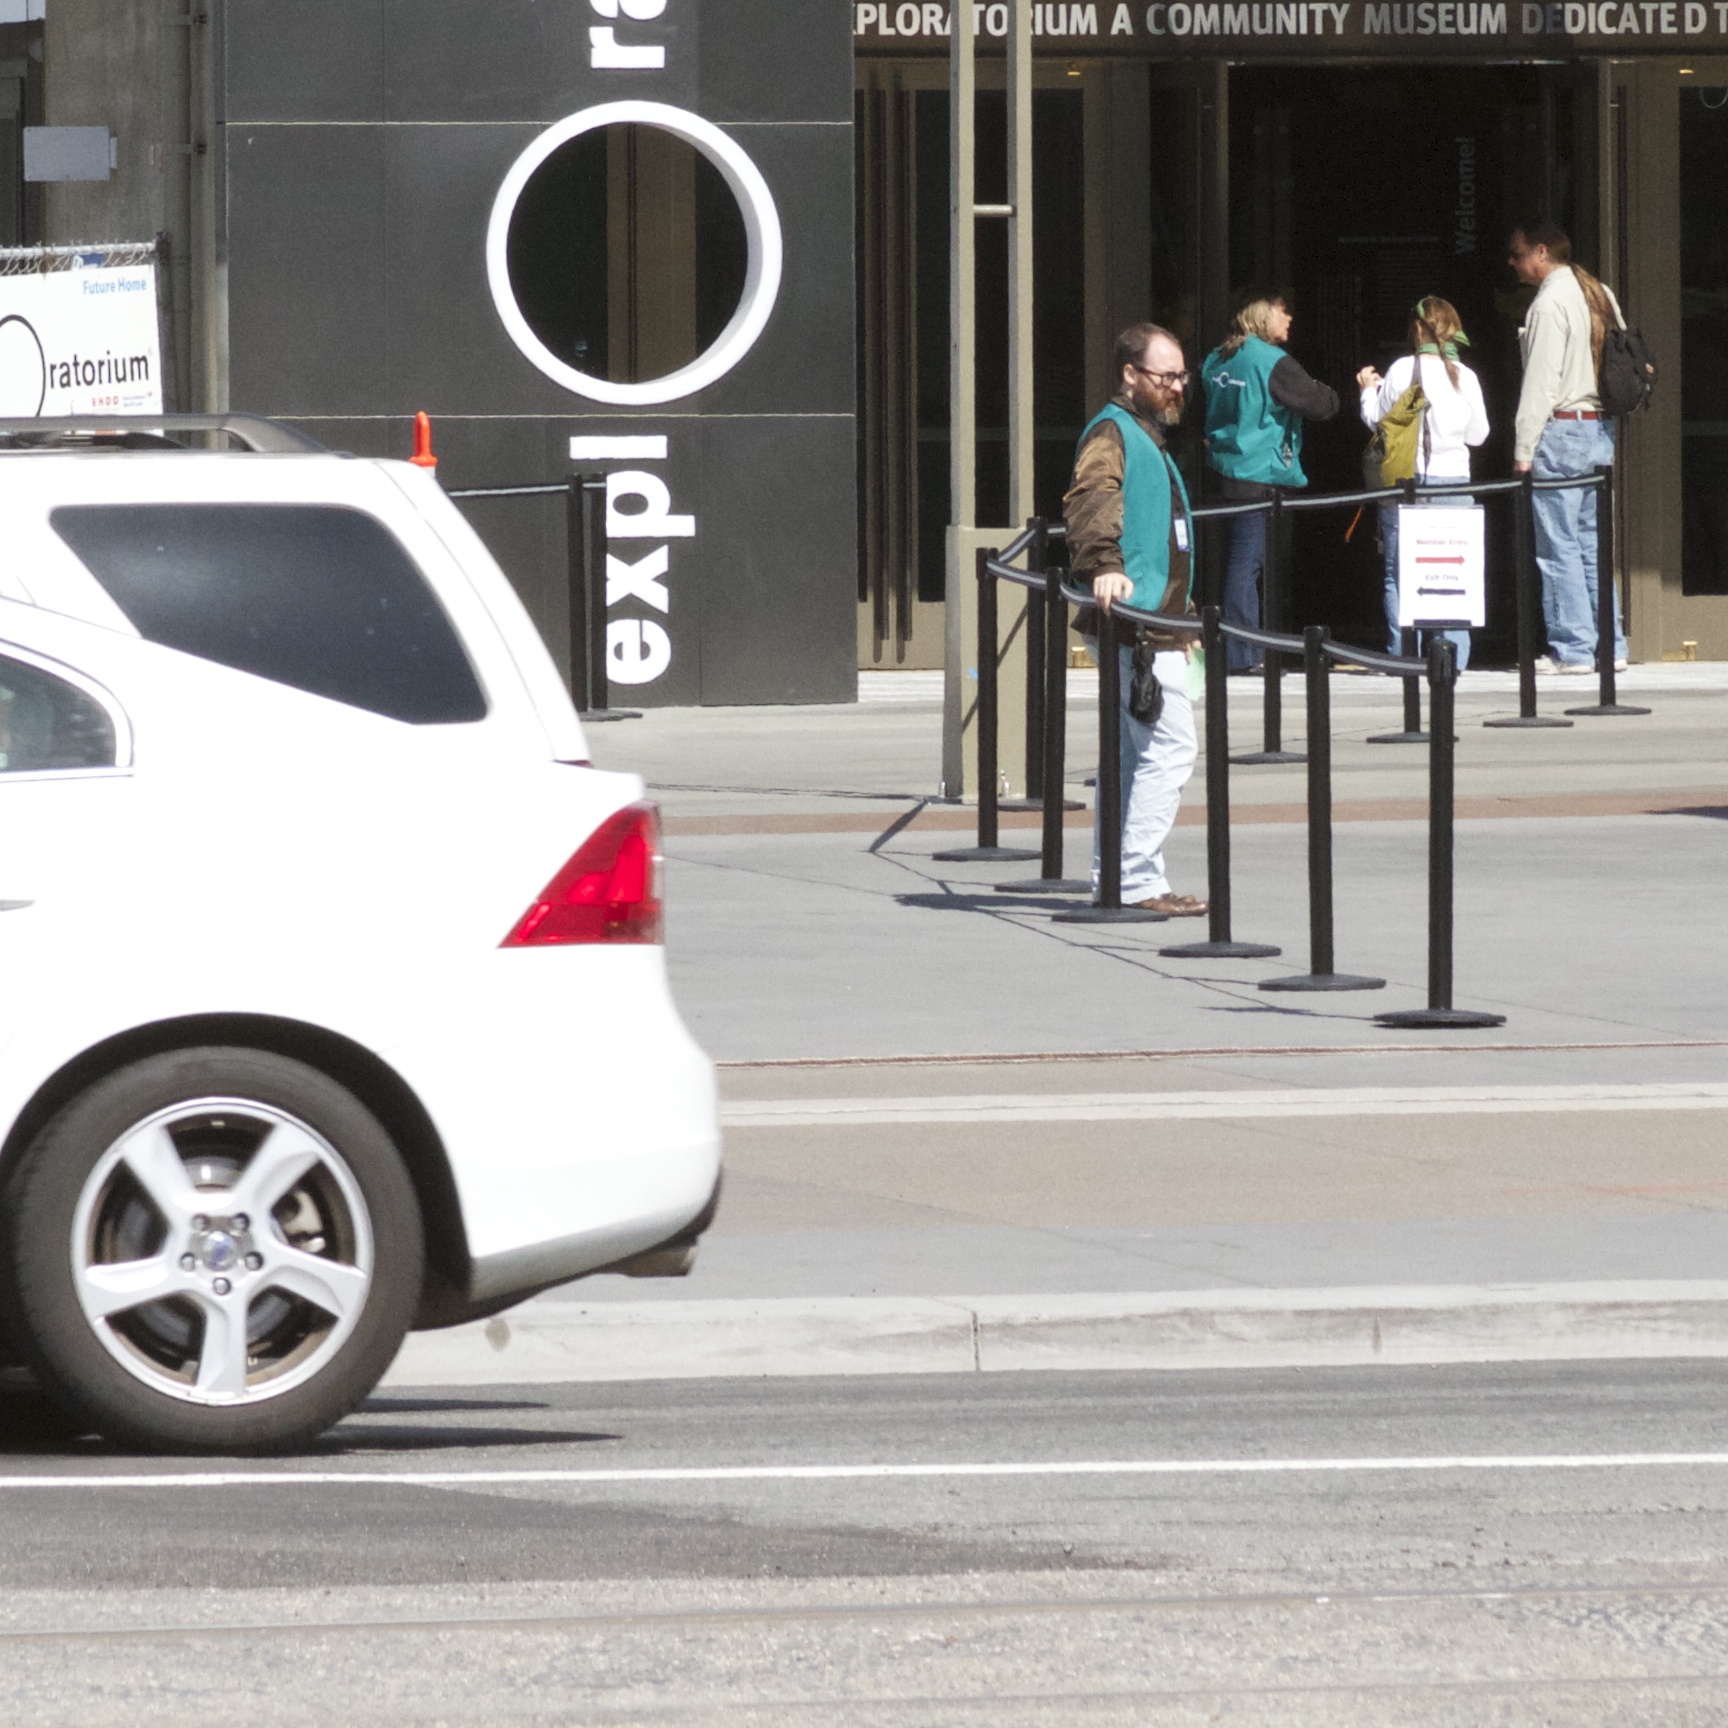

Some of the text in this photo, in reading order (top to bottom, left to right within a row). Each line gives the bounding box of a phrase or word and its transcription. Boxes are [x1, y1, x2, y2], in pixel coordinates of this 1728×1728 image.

[1110, 2, 1134, 36] A
[1145, 1, 1351, 37] COMMUNITY
[1363, 2, 1508, 36] MUSEUM
[1521, 1, 1707, 35] DEDICATED
[83, 277, 147, 295] Future Home
